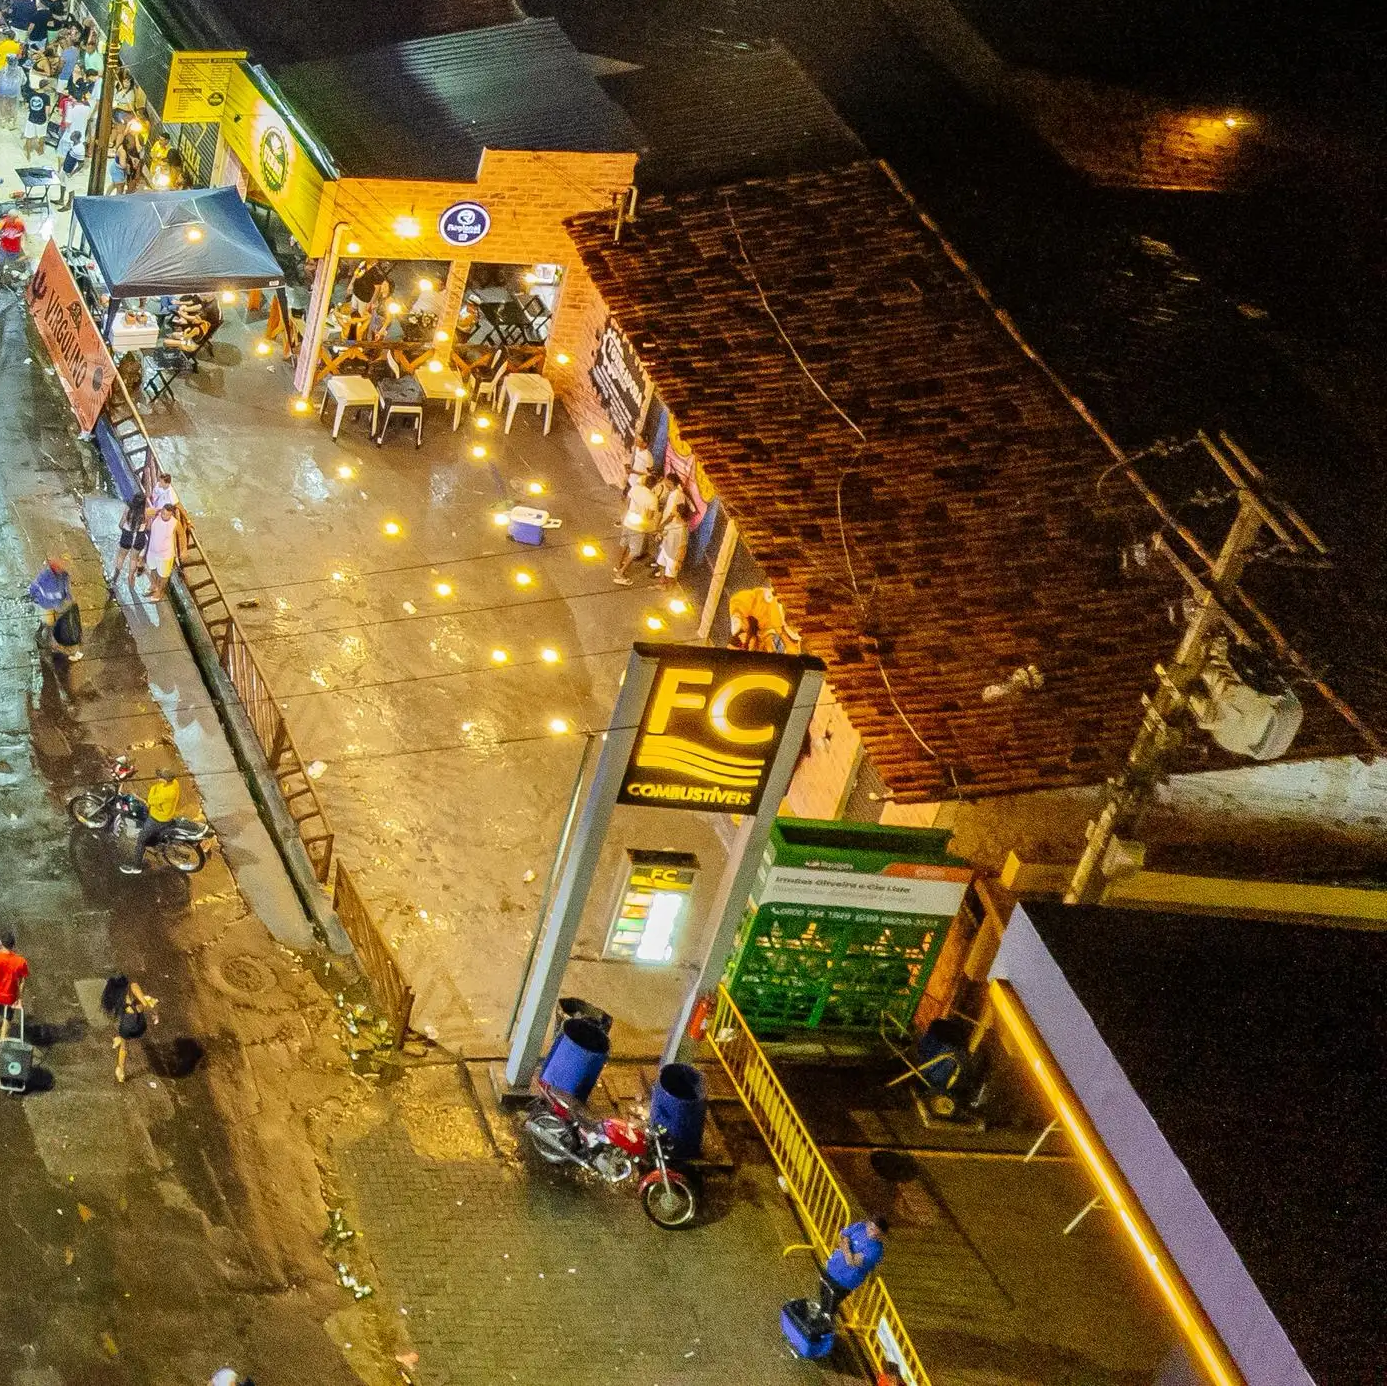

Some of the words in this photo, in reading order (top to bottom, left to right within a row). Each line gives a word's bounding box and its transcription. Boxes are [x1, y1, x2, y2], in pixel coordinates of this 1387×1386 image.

[44, 288, 88, 389] VIRGOLINO
[647, 668, 792, 744] FC
[627, 783, 752, 806] COMBUSTÍVEIS
[650, 868, 678, 881] FC
